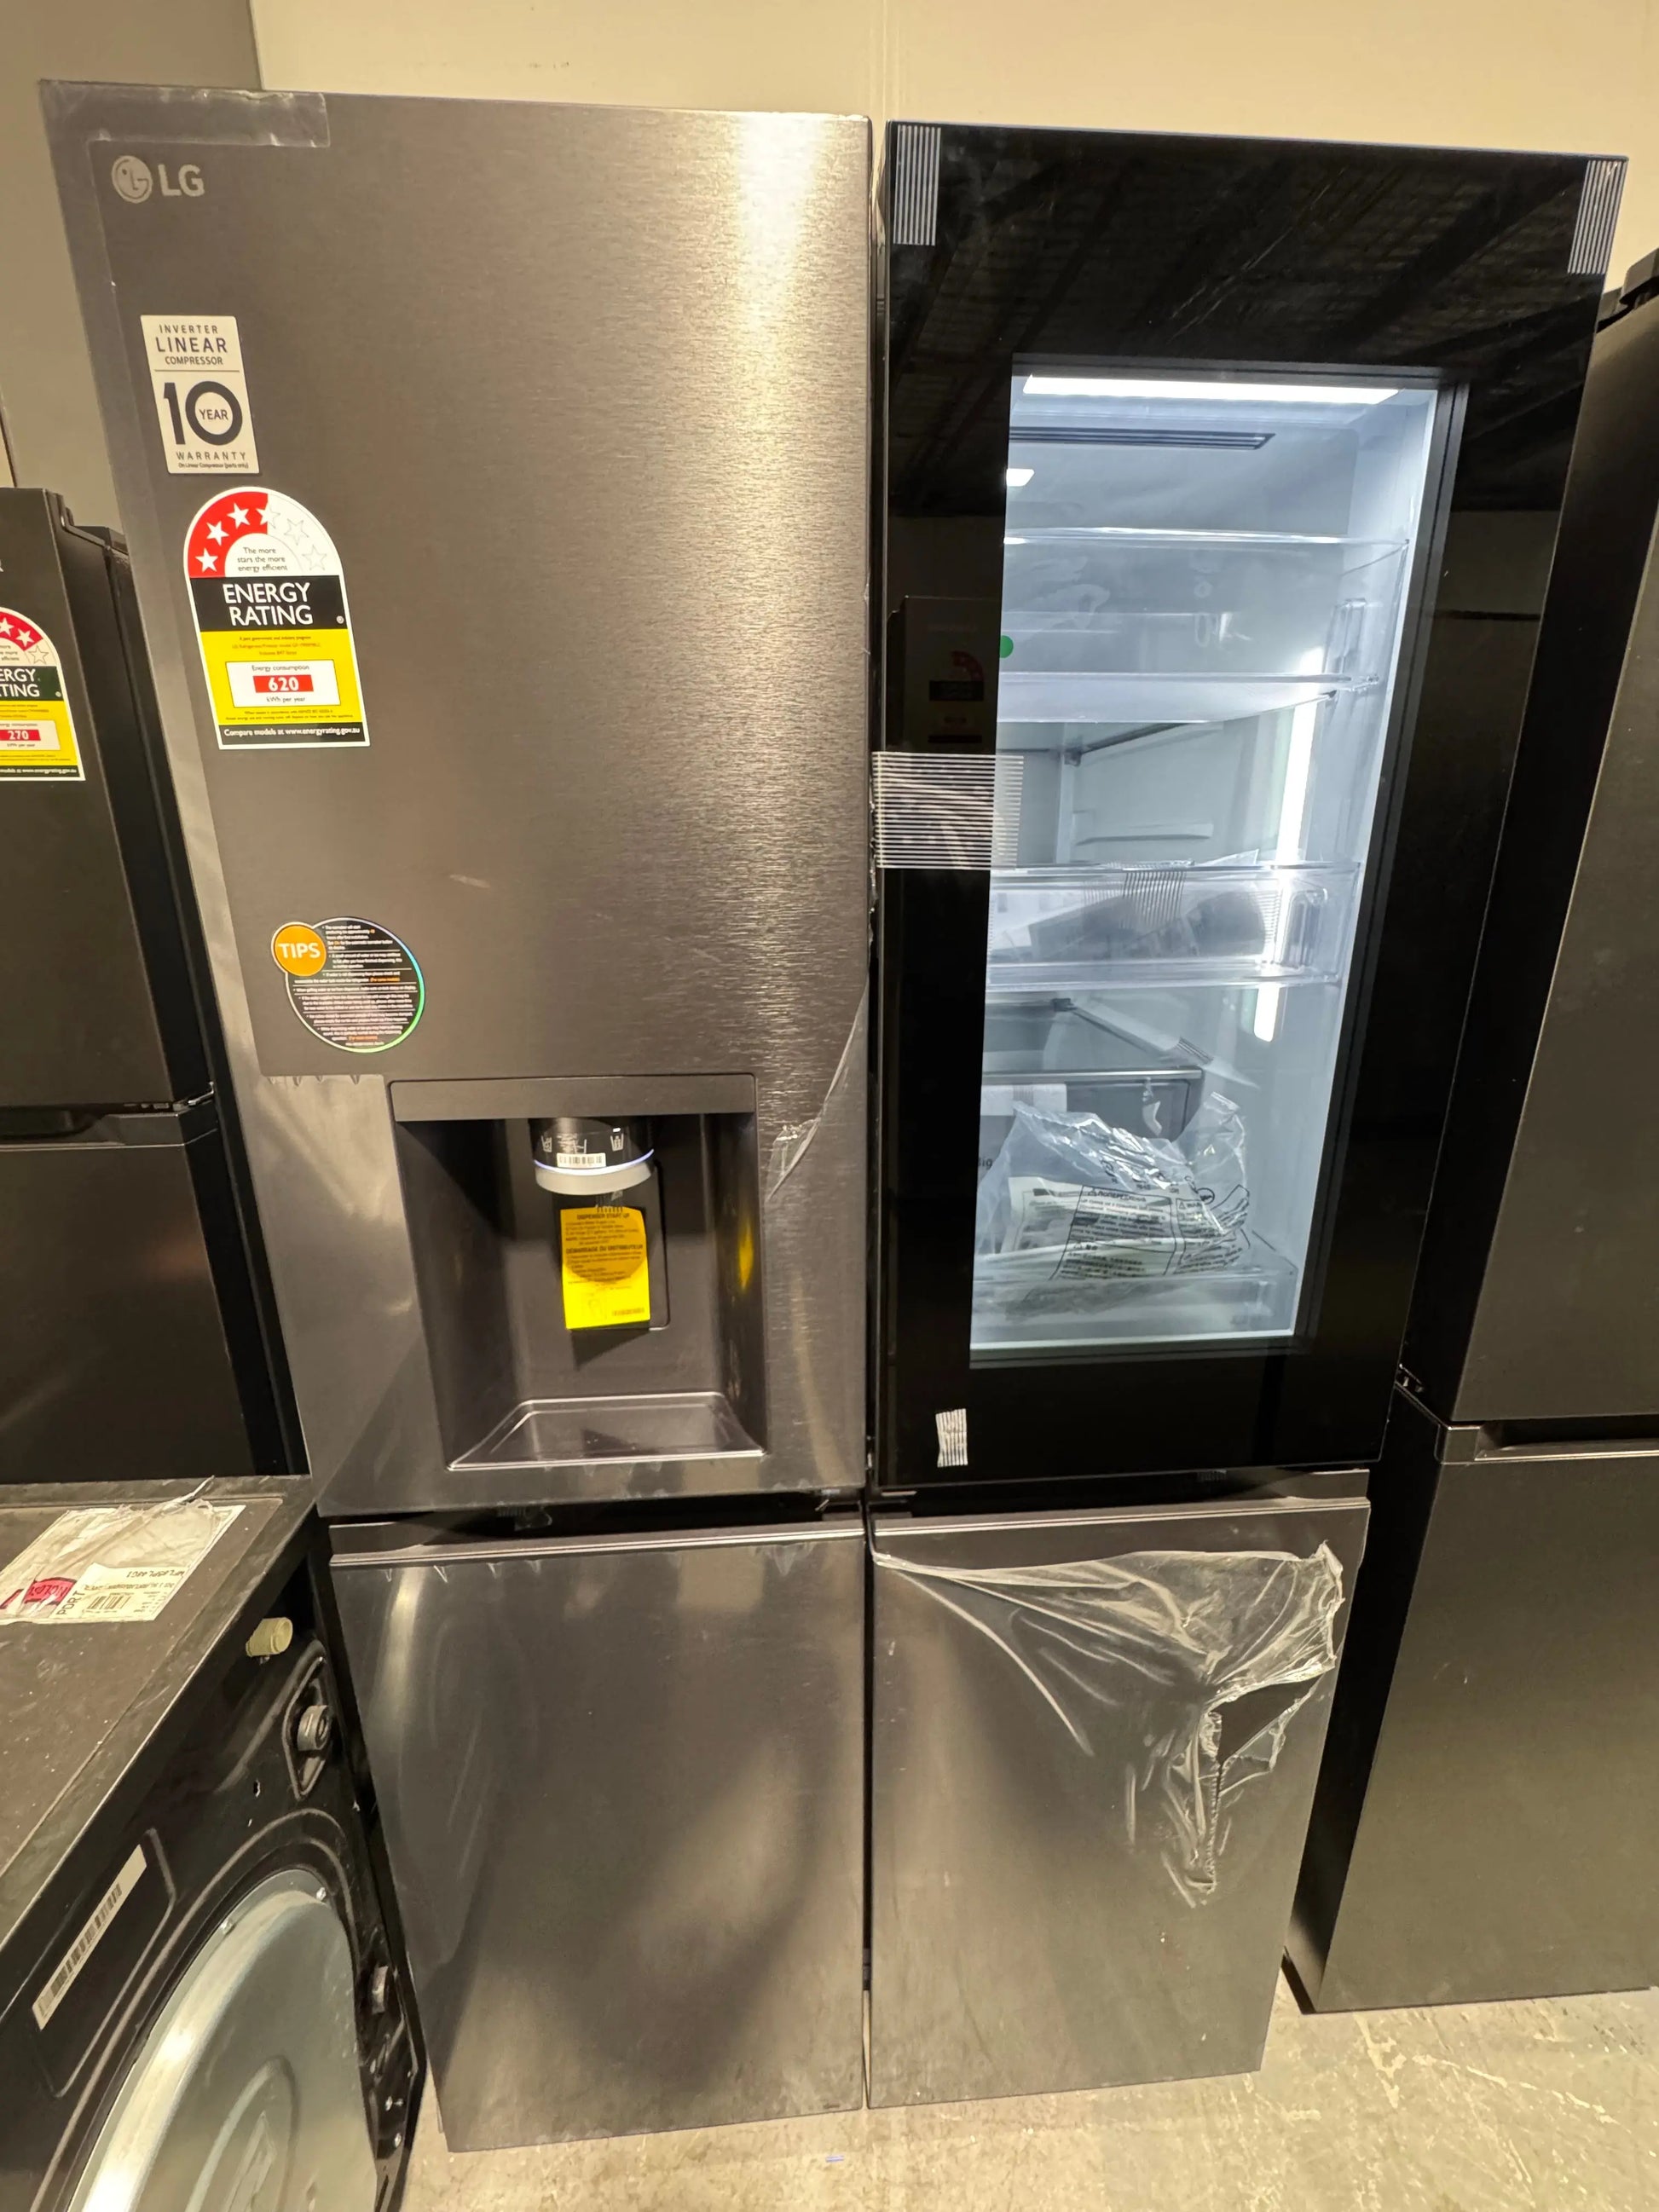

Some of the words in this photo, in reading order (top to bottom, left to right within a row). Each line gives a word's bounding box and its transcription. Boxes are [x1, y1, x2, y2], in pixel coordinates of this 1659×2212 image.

[158, 164, 205, 197] LG
[159, 324, 218, 335] INVERTER
[155, 337, 228, 354] LINEAR
[165, 355, 223, 366] COMPRESSOR
[163, 380, 243, 446] 10
[199, 408, 229, 421] YEAR
[176, 451, 247, 462] WARRANTY
[223, 582, 310, 604] ENERGY
[228, 604, 314, 627] RATING
[251, 664, 272, 673] Energy
[273, 664, 309, 673] consumption
[0, 683, 40, 697] TING
[268, 676, 299, 692] 620
[7, 730, 30, 741] 270
[223, 729, 253, 737] Compare
[278, 942, 321, 959] TIPS
